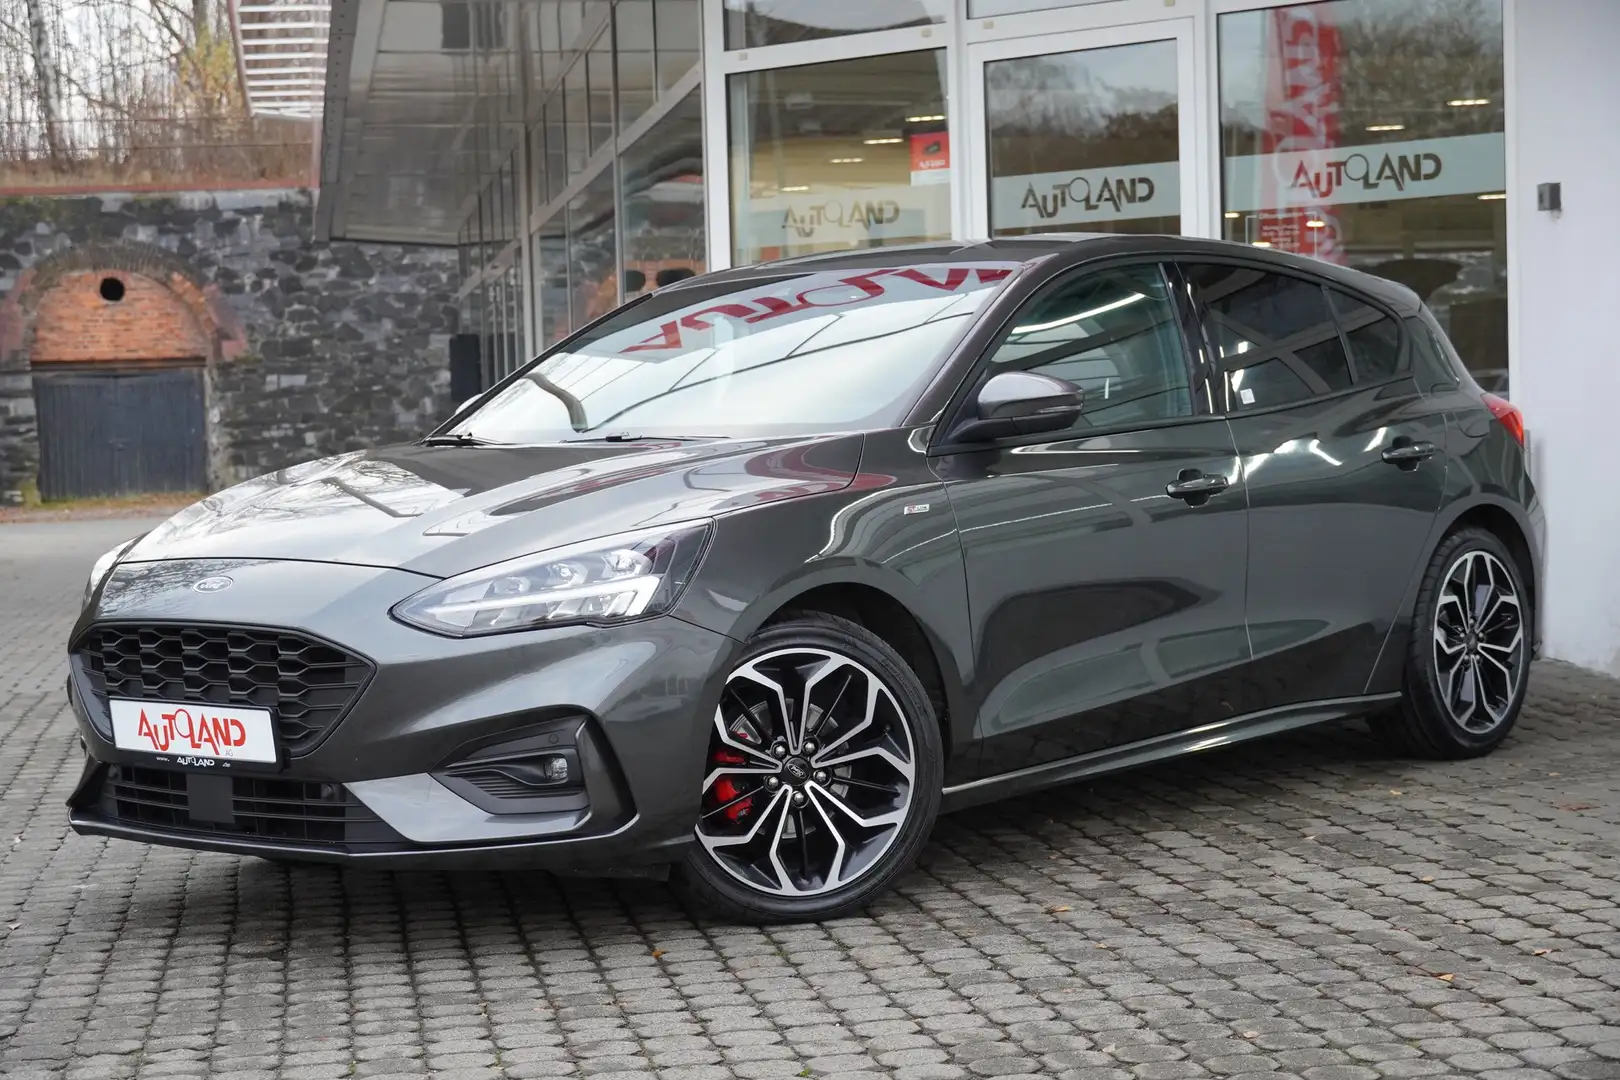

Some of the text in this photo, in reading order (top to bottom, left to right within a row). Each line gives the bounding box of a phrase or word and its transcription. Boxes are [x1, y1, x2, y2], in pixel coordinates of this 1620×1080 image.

[1291, 153, 1442, 198] AUTOLAND
[1021, 176, 1155, 218] AUTOLAND
[781, 200, 900, 238] AUTOLAND
[137, 708, 247, 755] AUTOLAND
[177, 756, 215, 767] AUTOLAND
[225, 748, 234, 757] AG
